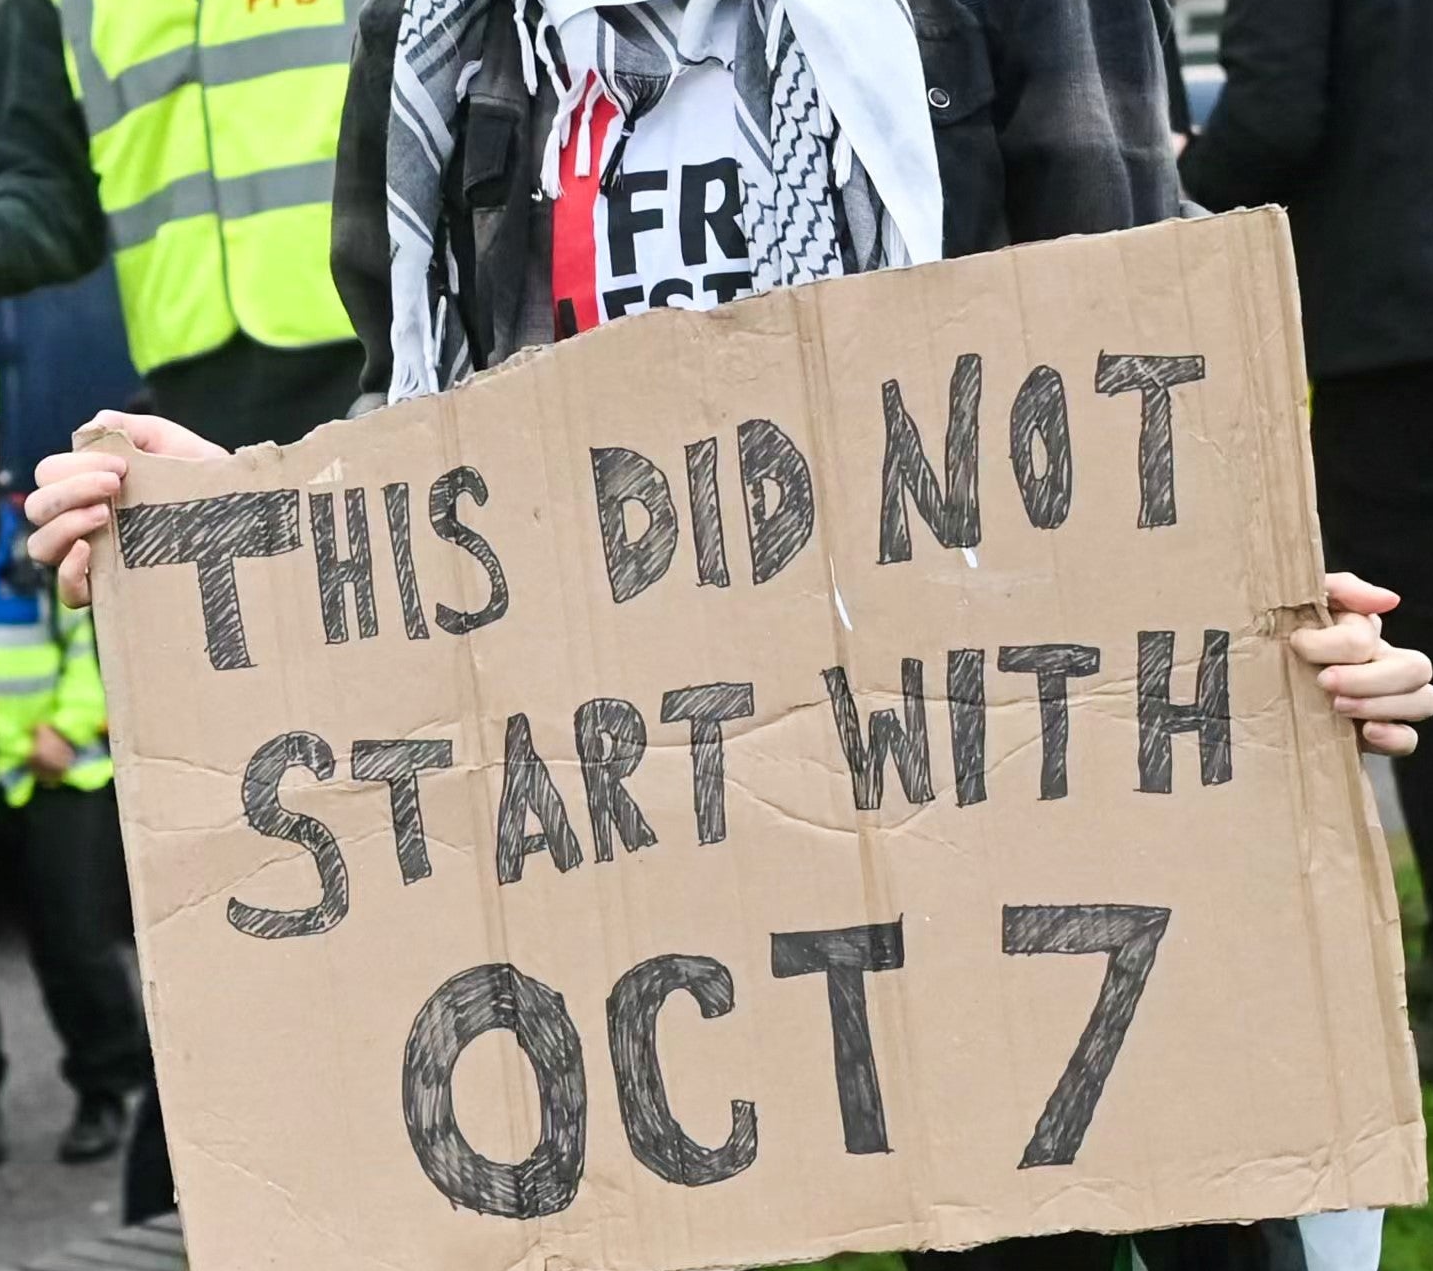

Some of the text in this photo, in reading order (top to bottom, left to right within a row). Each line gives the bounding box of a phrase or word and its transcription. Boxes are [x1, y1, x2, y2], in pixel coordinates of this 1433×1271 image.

[605, 156, 749, 278] FR
[116, 350, 1207, 671] THIS DID NOT
[226, 629, 1234, 940] START WITH
[402, 903, 1173, 1221] OCT 7
